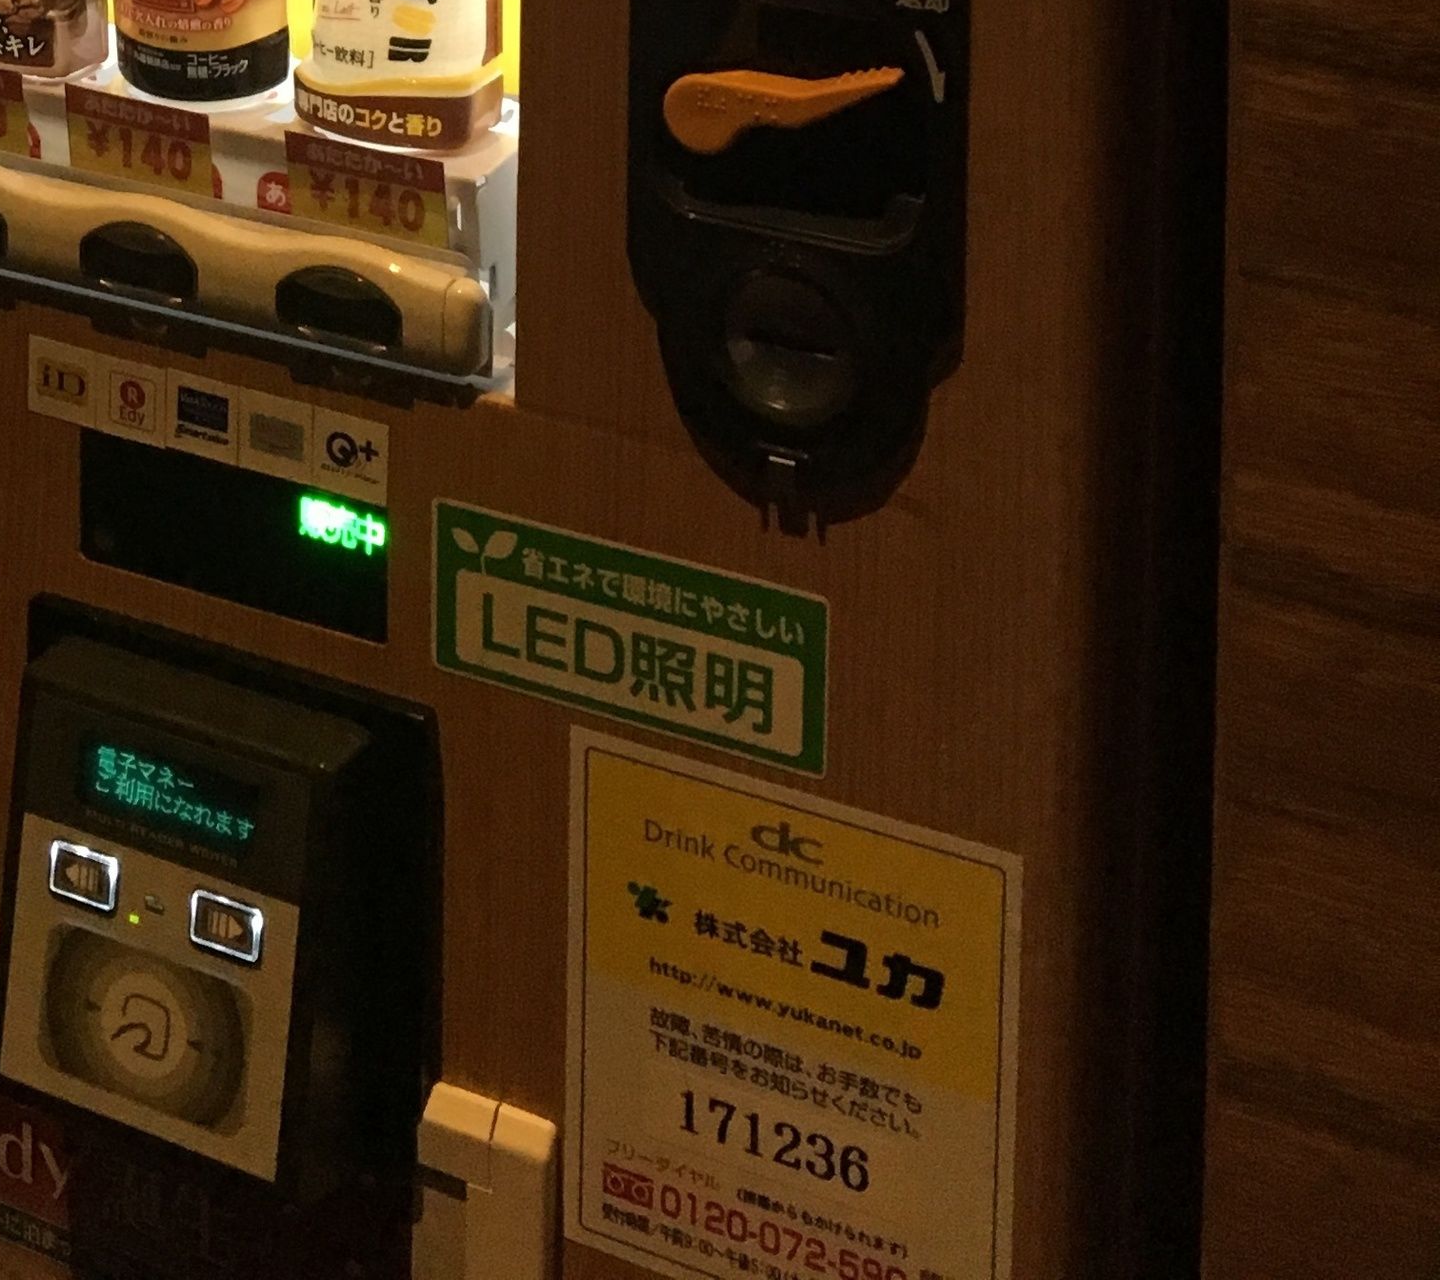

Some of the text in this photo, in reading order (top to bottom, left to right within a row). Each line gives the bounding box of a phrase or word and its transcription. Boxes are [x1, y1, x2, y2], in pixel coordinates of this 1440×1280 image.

[186, 53, 229, 66] コーヒー
[297, 94, 443, 138] 専門店のコクと香り
[118, 405, 146, 427] Edy
[522, 546, 806, 646] 省エネで環境にやさしい
[482, 591, 775, 736] LED照明
[94, 773, 256, 841] ご利用になれます
[97, 744, 195, 789] 電子マネー
[644, 818, 943, 930] Drink Communication
[649, 956, 923, 1062] http://www.yukanet.co.jp
[694, 908, 946, 1012] 株式会社ユカ
[648, 1030, 922, 1142] 下記番号をお知らせください。
[649, 1006, 924, 1116] 故障、苦情の際は、お手数でも
[604, 1139, 721, 1192] フリーダイヤル
[678, 1088, 872, 1193] 171236
